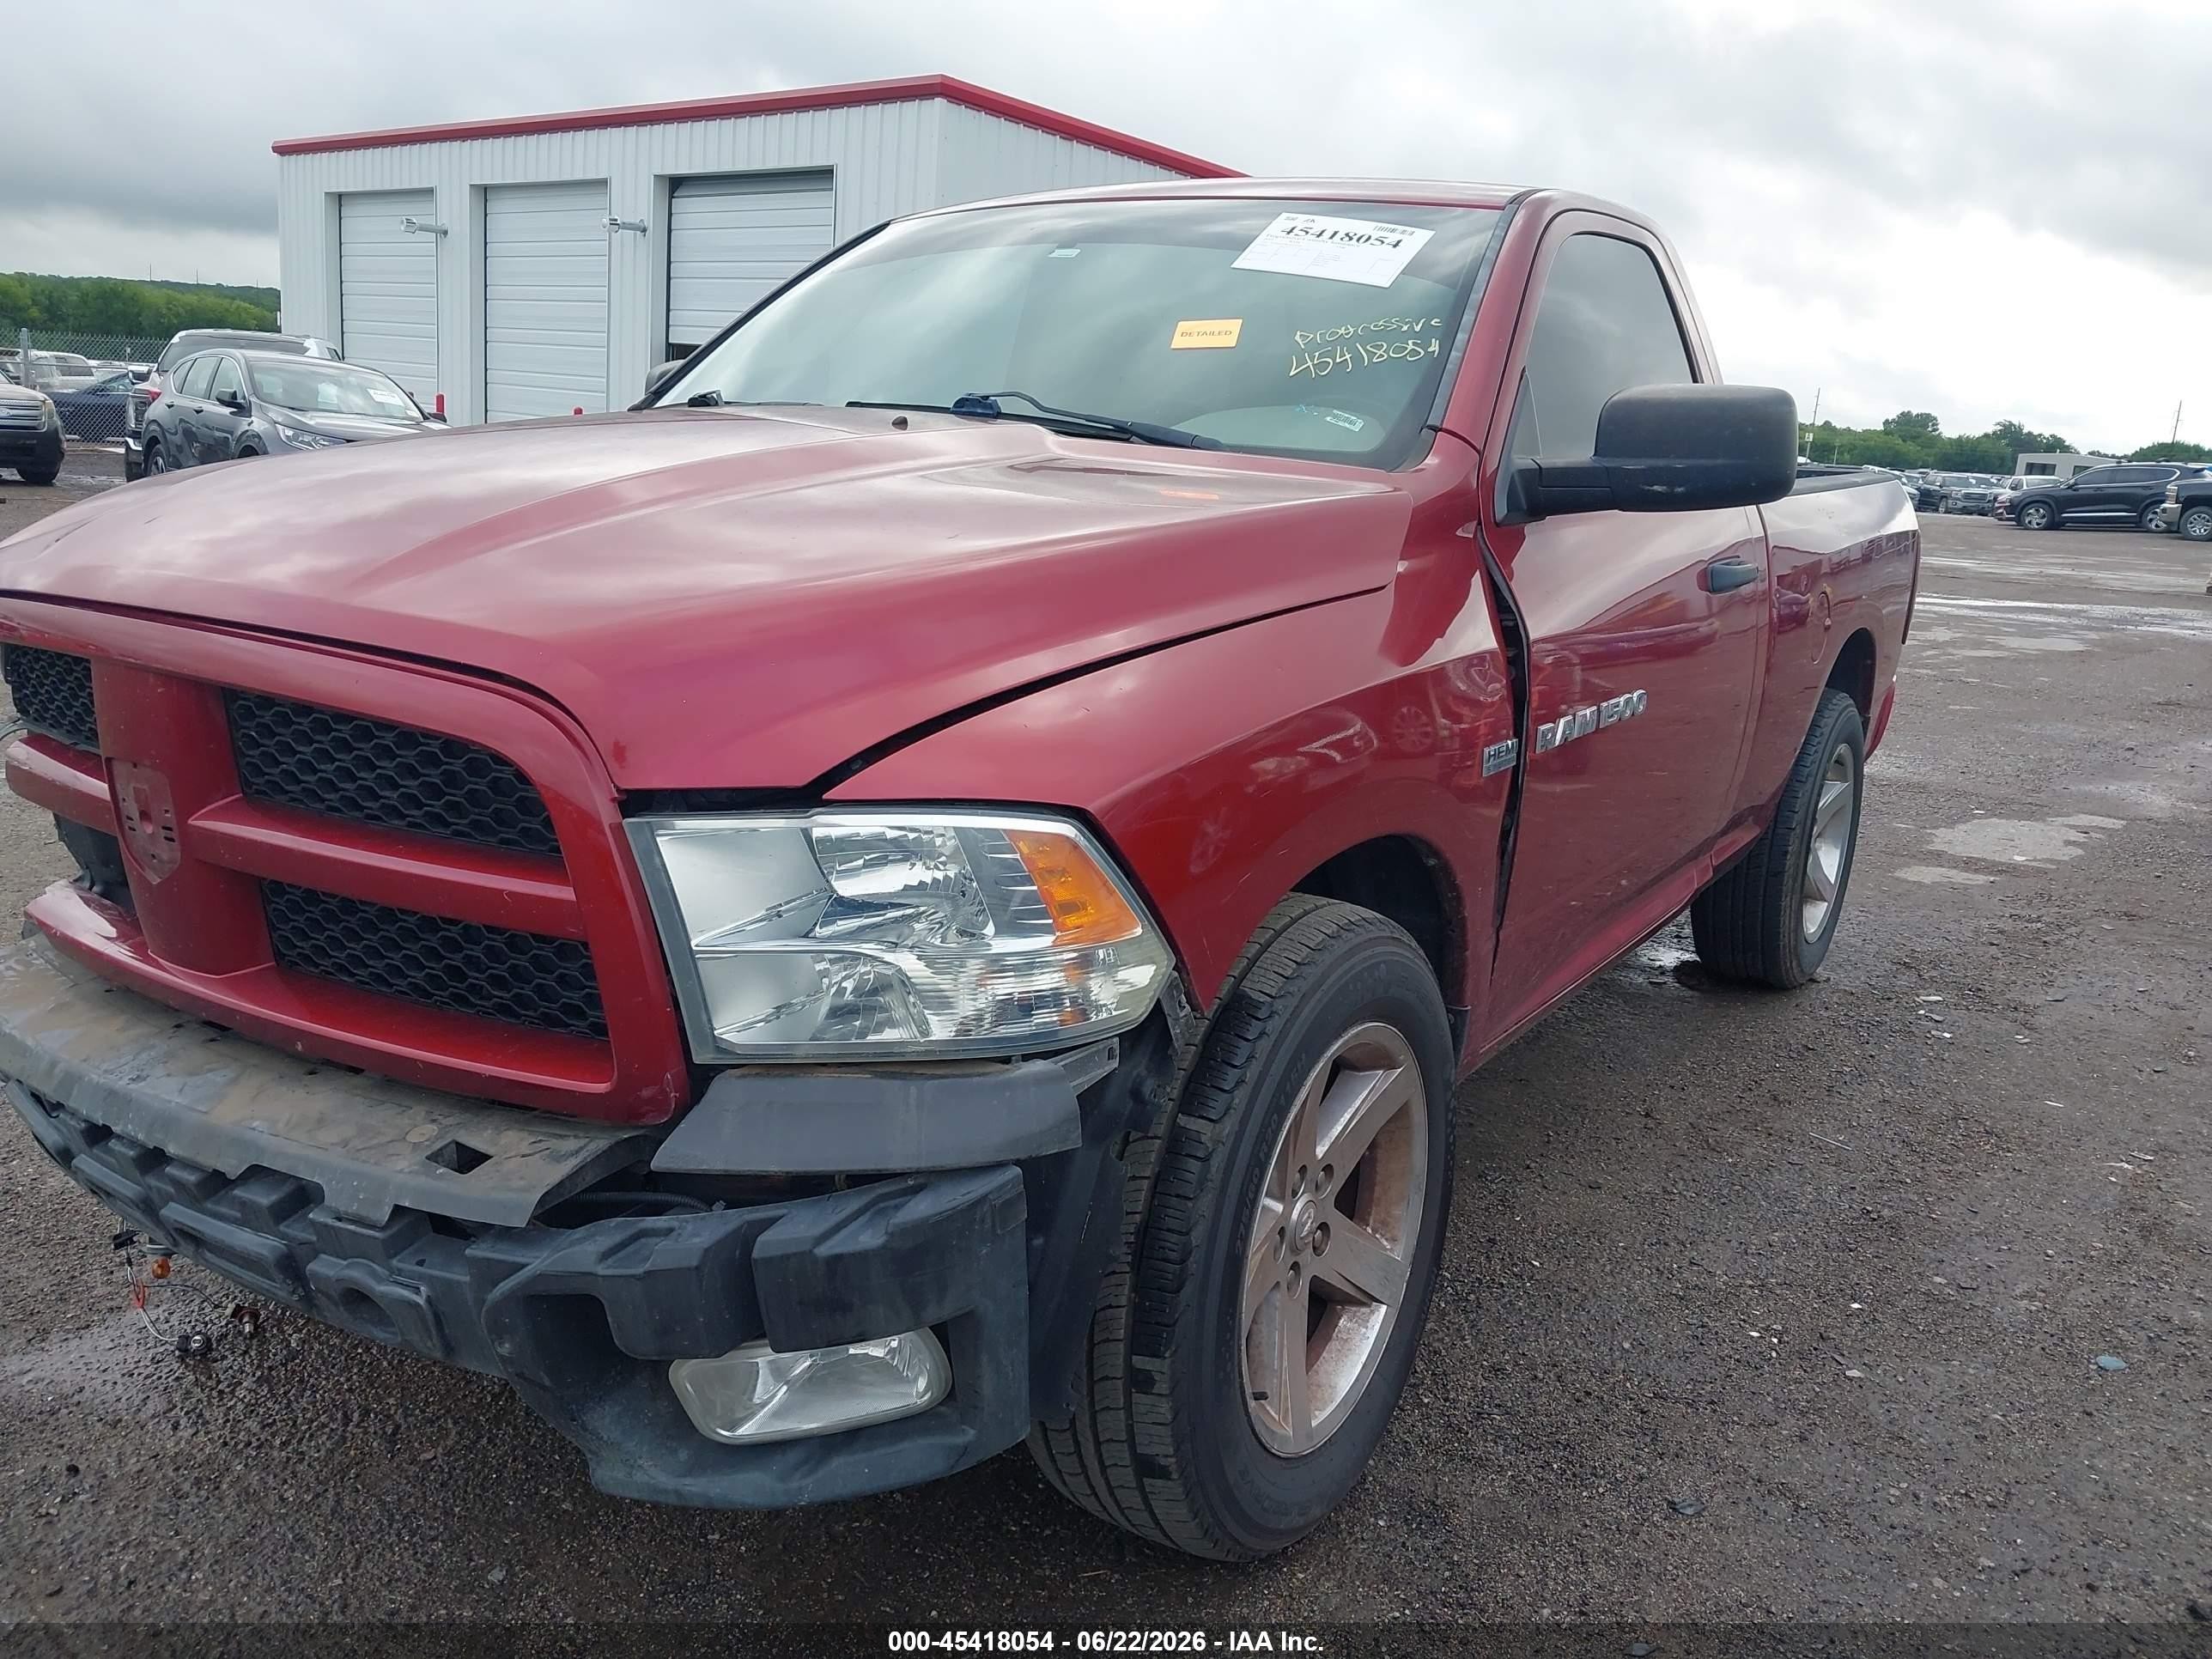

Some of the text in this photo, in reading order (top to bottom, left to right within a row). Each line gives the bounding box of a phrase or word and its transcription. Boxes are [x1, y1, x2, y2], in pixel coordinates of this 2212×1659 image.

[1280, 225, 1404, 249] 45418054
[1289, 338, 1440, 379] 45418054
[1535, 689, 1648, 754] RAM 1500
[1487, 740, 1518, 763] HEMI
